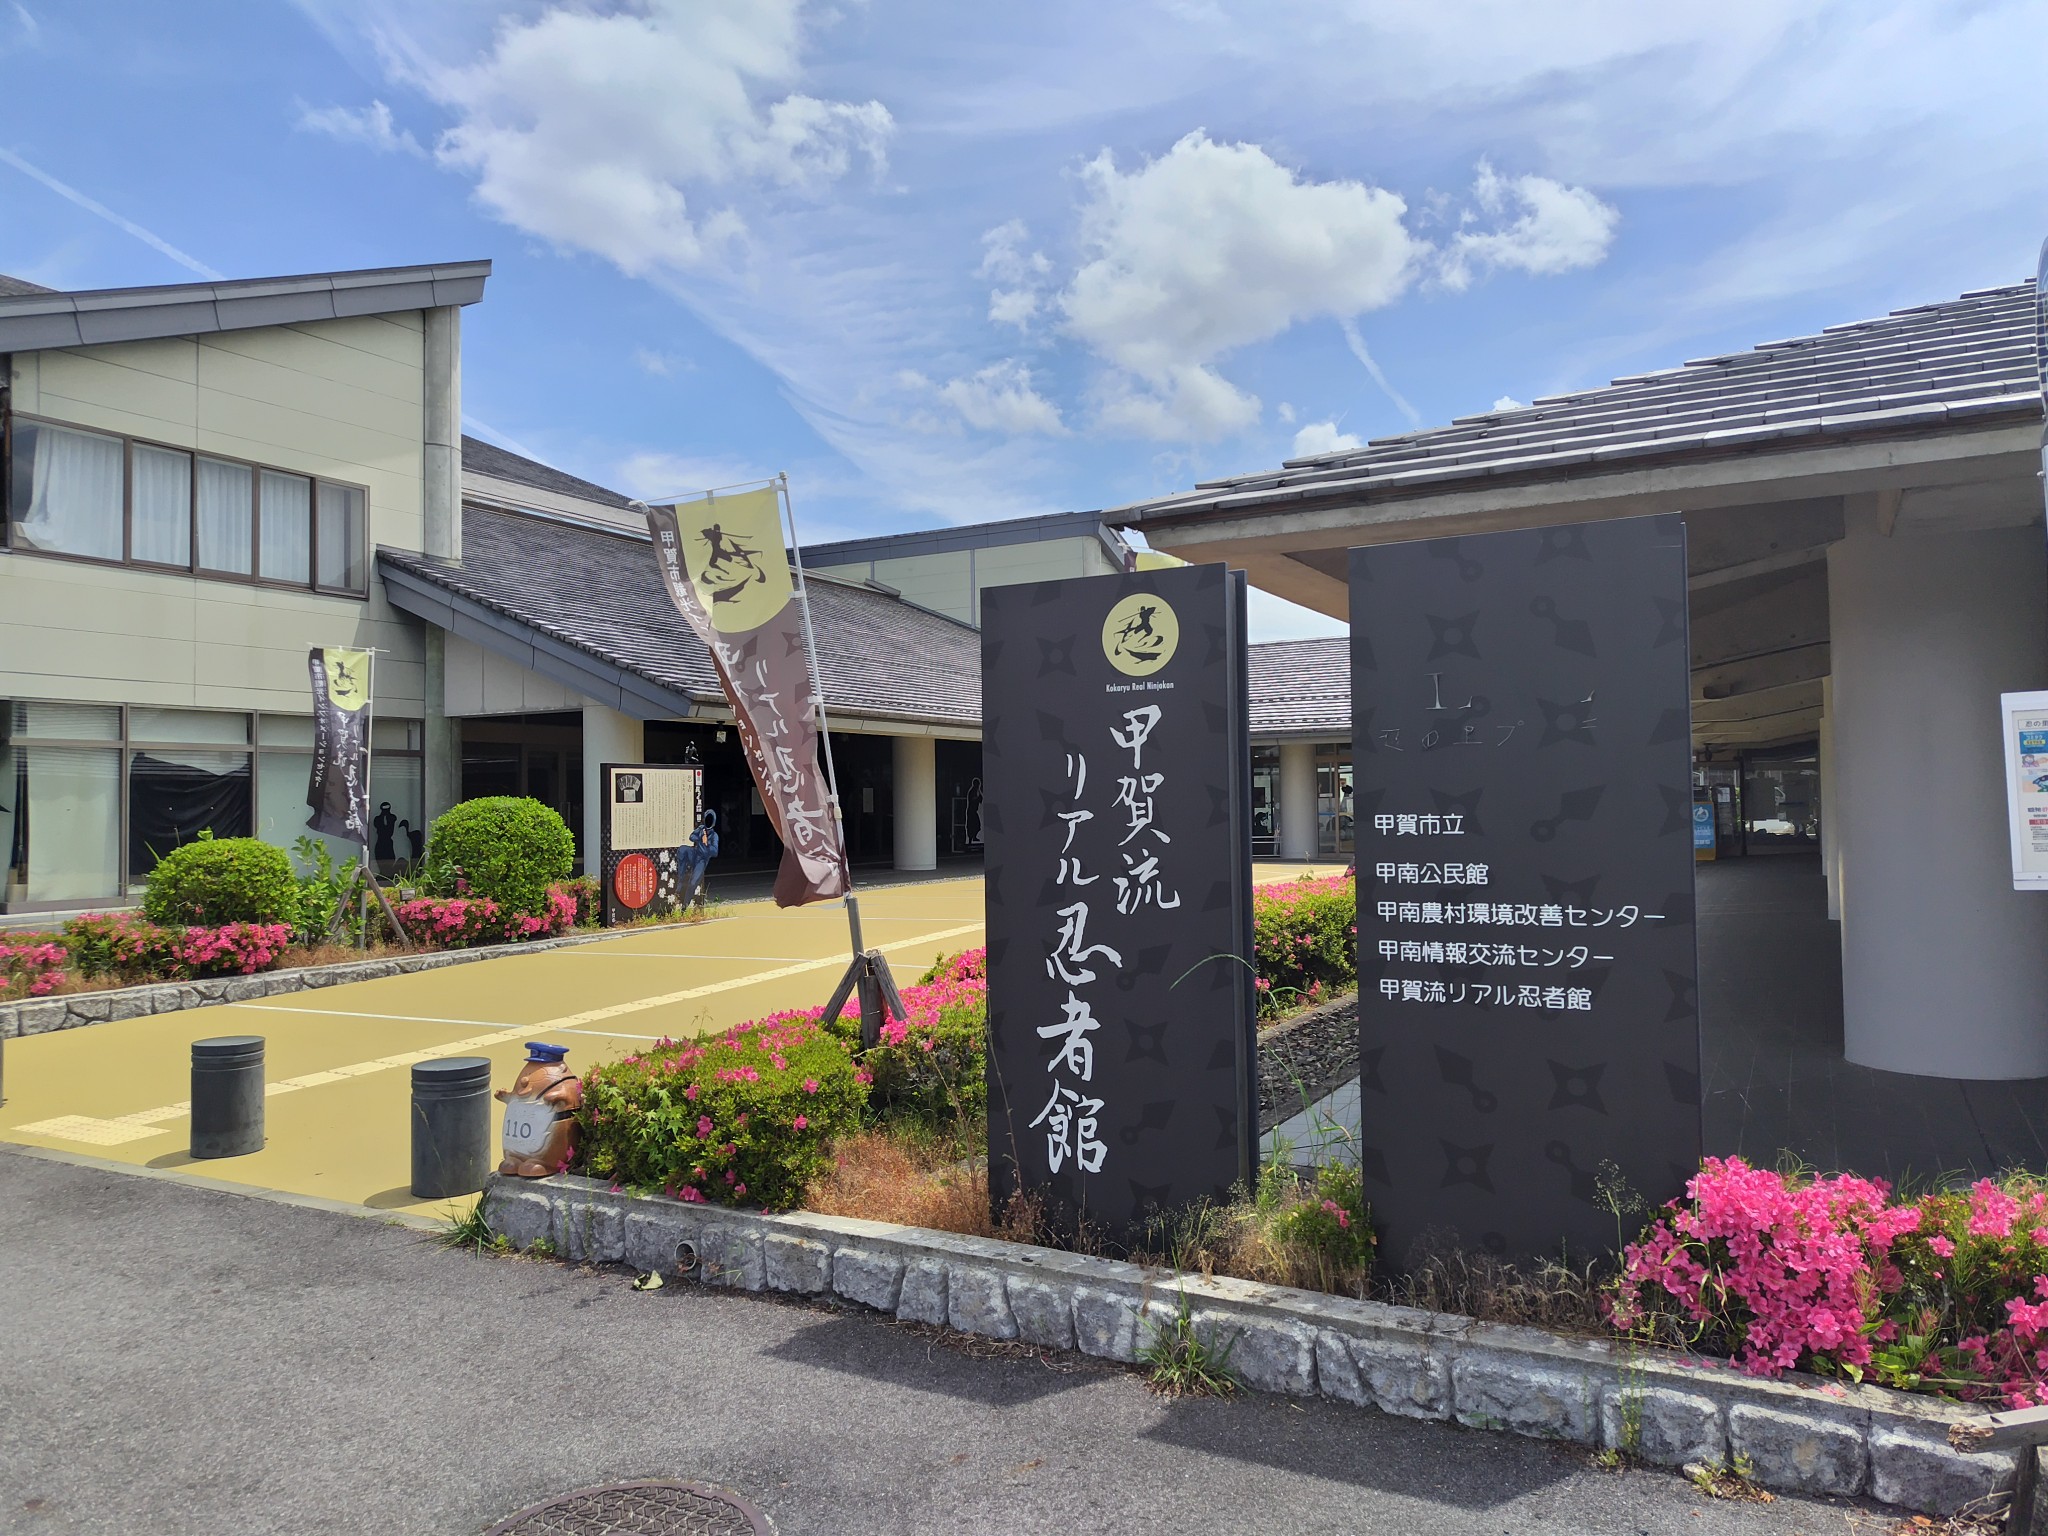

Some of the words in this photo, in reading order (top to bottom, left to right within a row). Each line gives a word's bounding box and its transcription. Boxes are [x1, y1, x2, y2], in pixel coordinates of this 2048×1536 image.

[1105, 683, 1131, 693] Kokaryu
[1132, 681, 1145, 691] Real
[1147, 680, 1174, 691] Ninjakan
[1109, 704, 1181, 915] 甲賀流
[1374, 813, 1465, 837] 甲賀市立
[1376, 862, 1489, 886] 甲南公民館
[1377, 901, 1666, 928] 甲南農村環境改善センター
[1028, 753, 1123, 1174] リアル忍者館
[1378, 940, 1615, 969] 甲南情報交流センター
[1379, 978, 1593, 1012] 甲賀流リアル忍者館
[505, 1119, 532, 1139] 110
